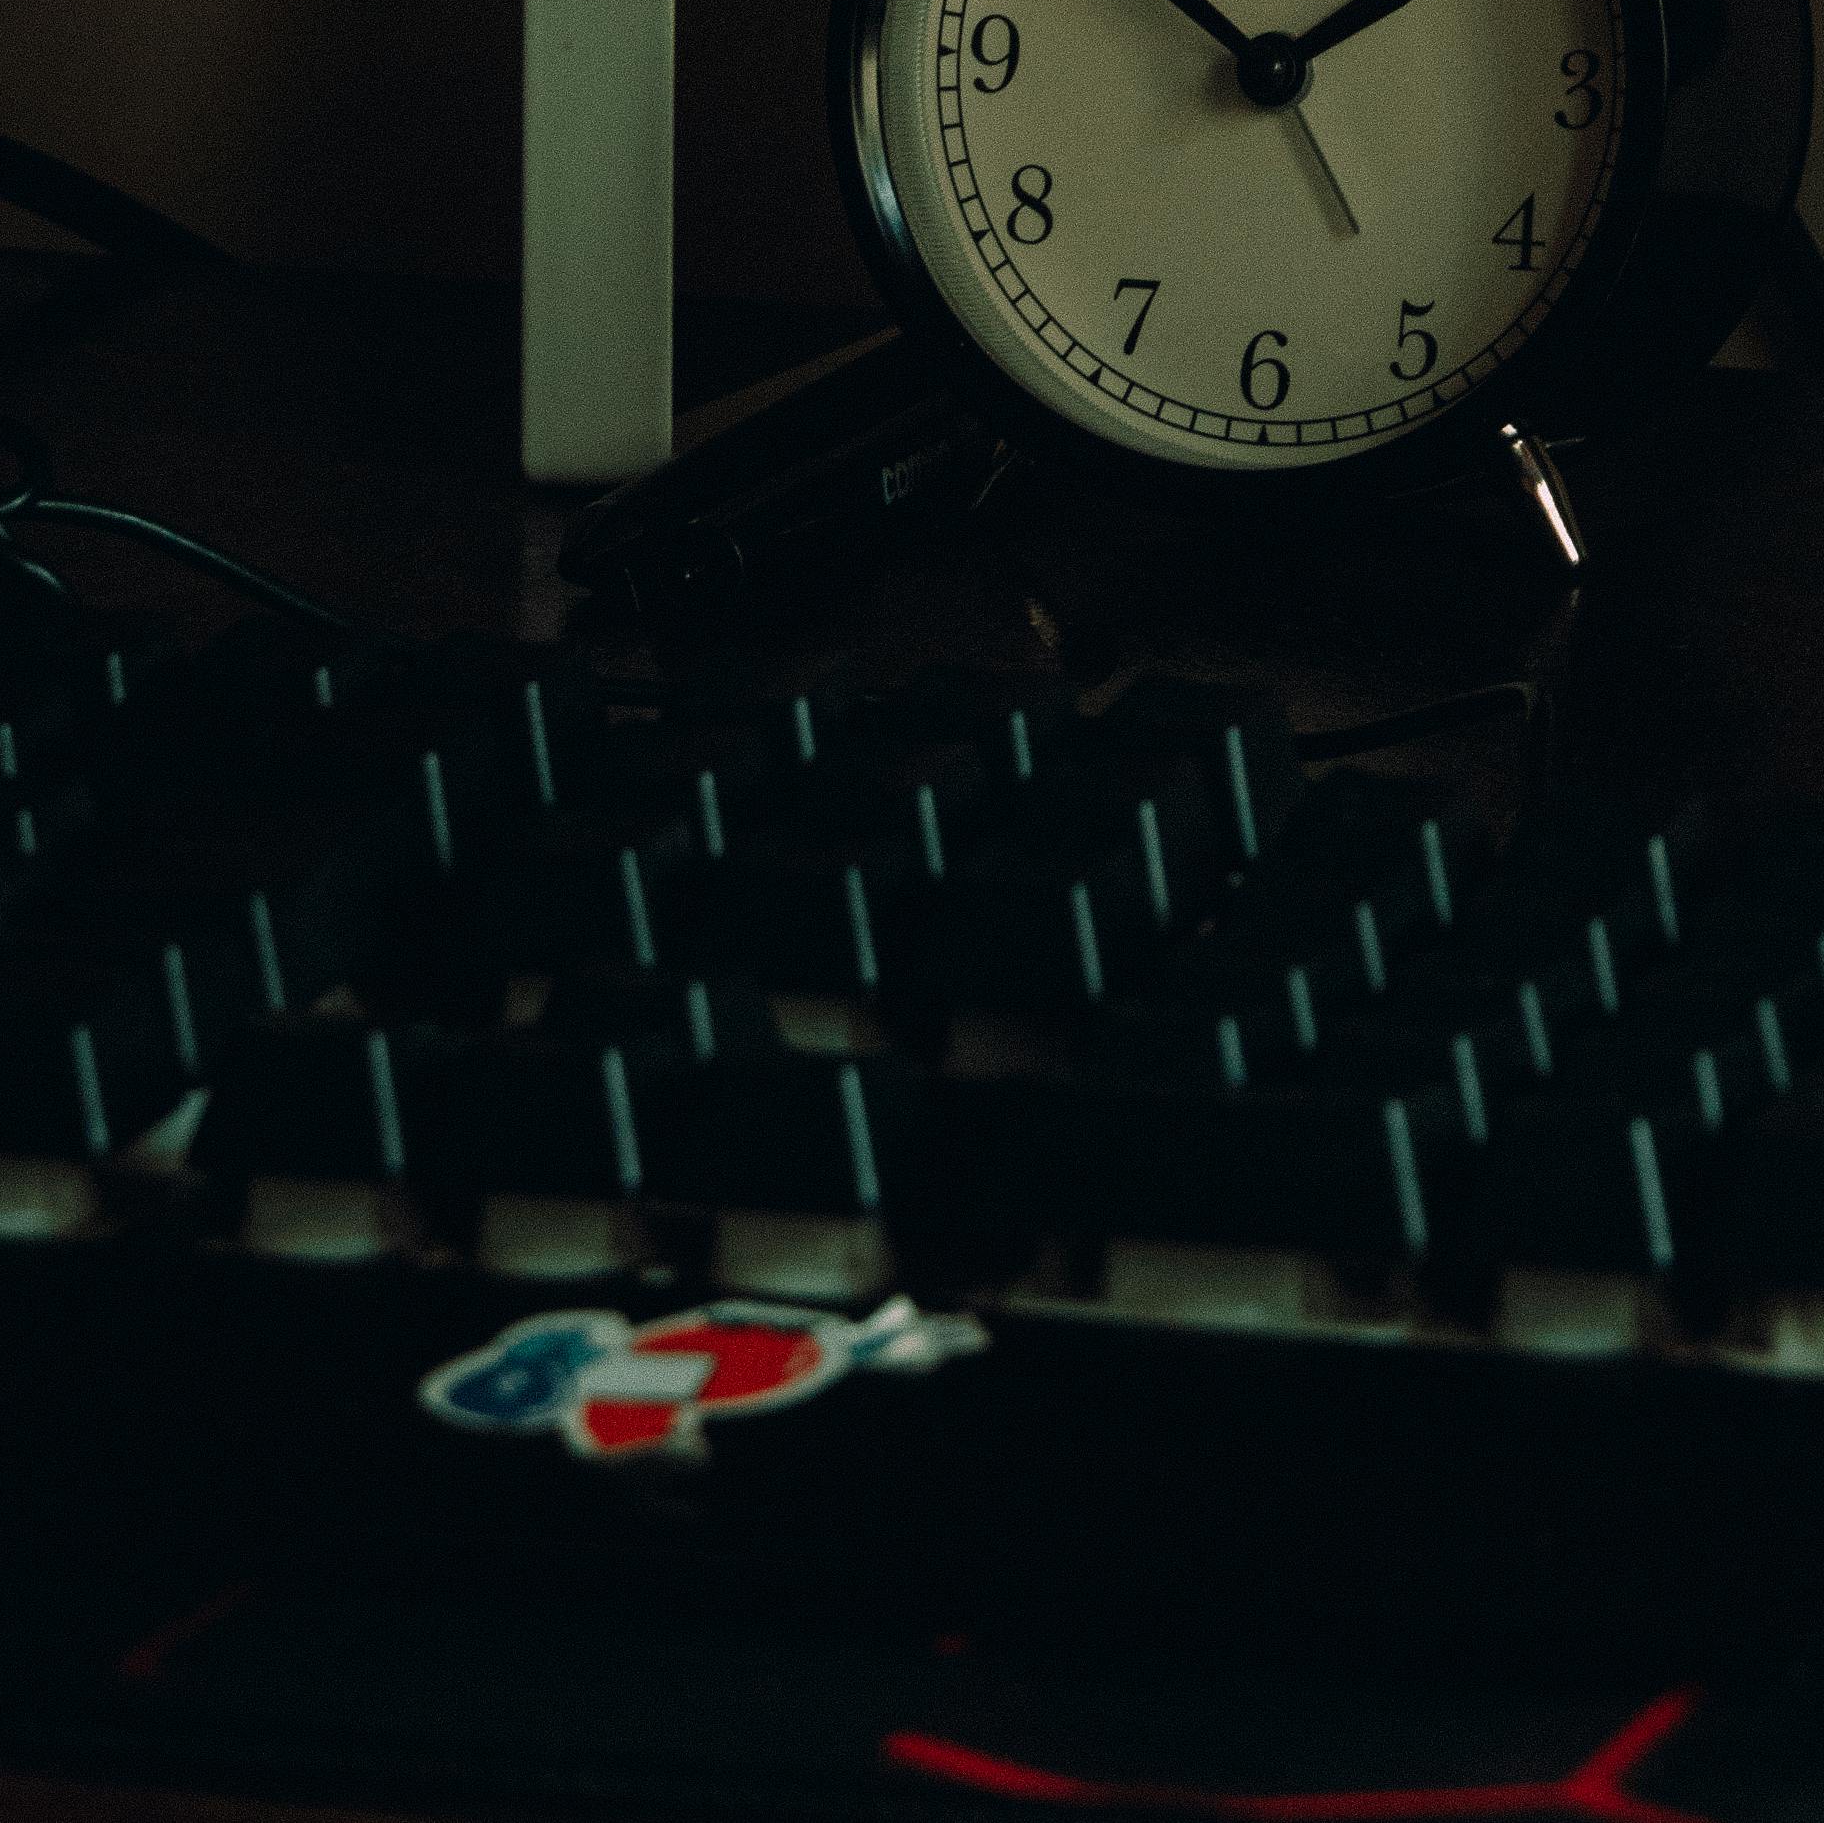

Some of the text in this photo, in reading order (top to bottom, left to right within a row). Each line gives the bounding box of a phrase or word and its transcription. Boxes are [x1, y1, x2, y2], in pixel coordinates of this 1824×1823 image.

[970, 14, 1021, 94] 9
[1553, 49, 1602, 130] 3
[1006, 164, 1054, 245] 8
[1491, 193, 1546, 272] 4
[1112, 278, 1162, 355] 7
[1389, 299, 1438, 381] 5
[1239, 330, 1291, 411] 6
